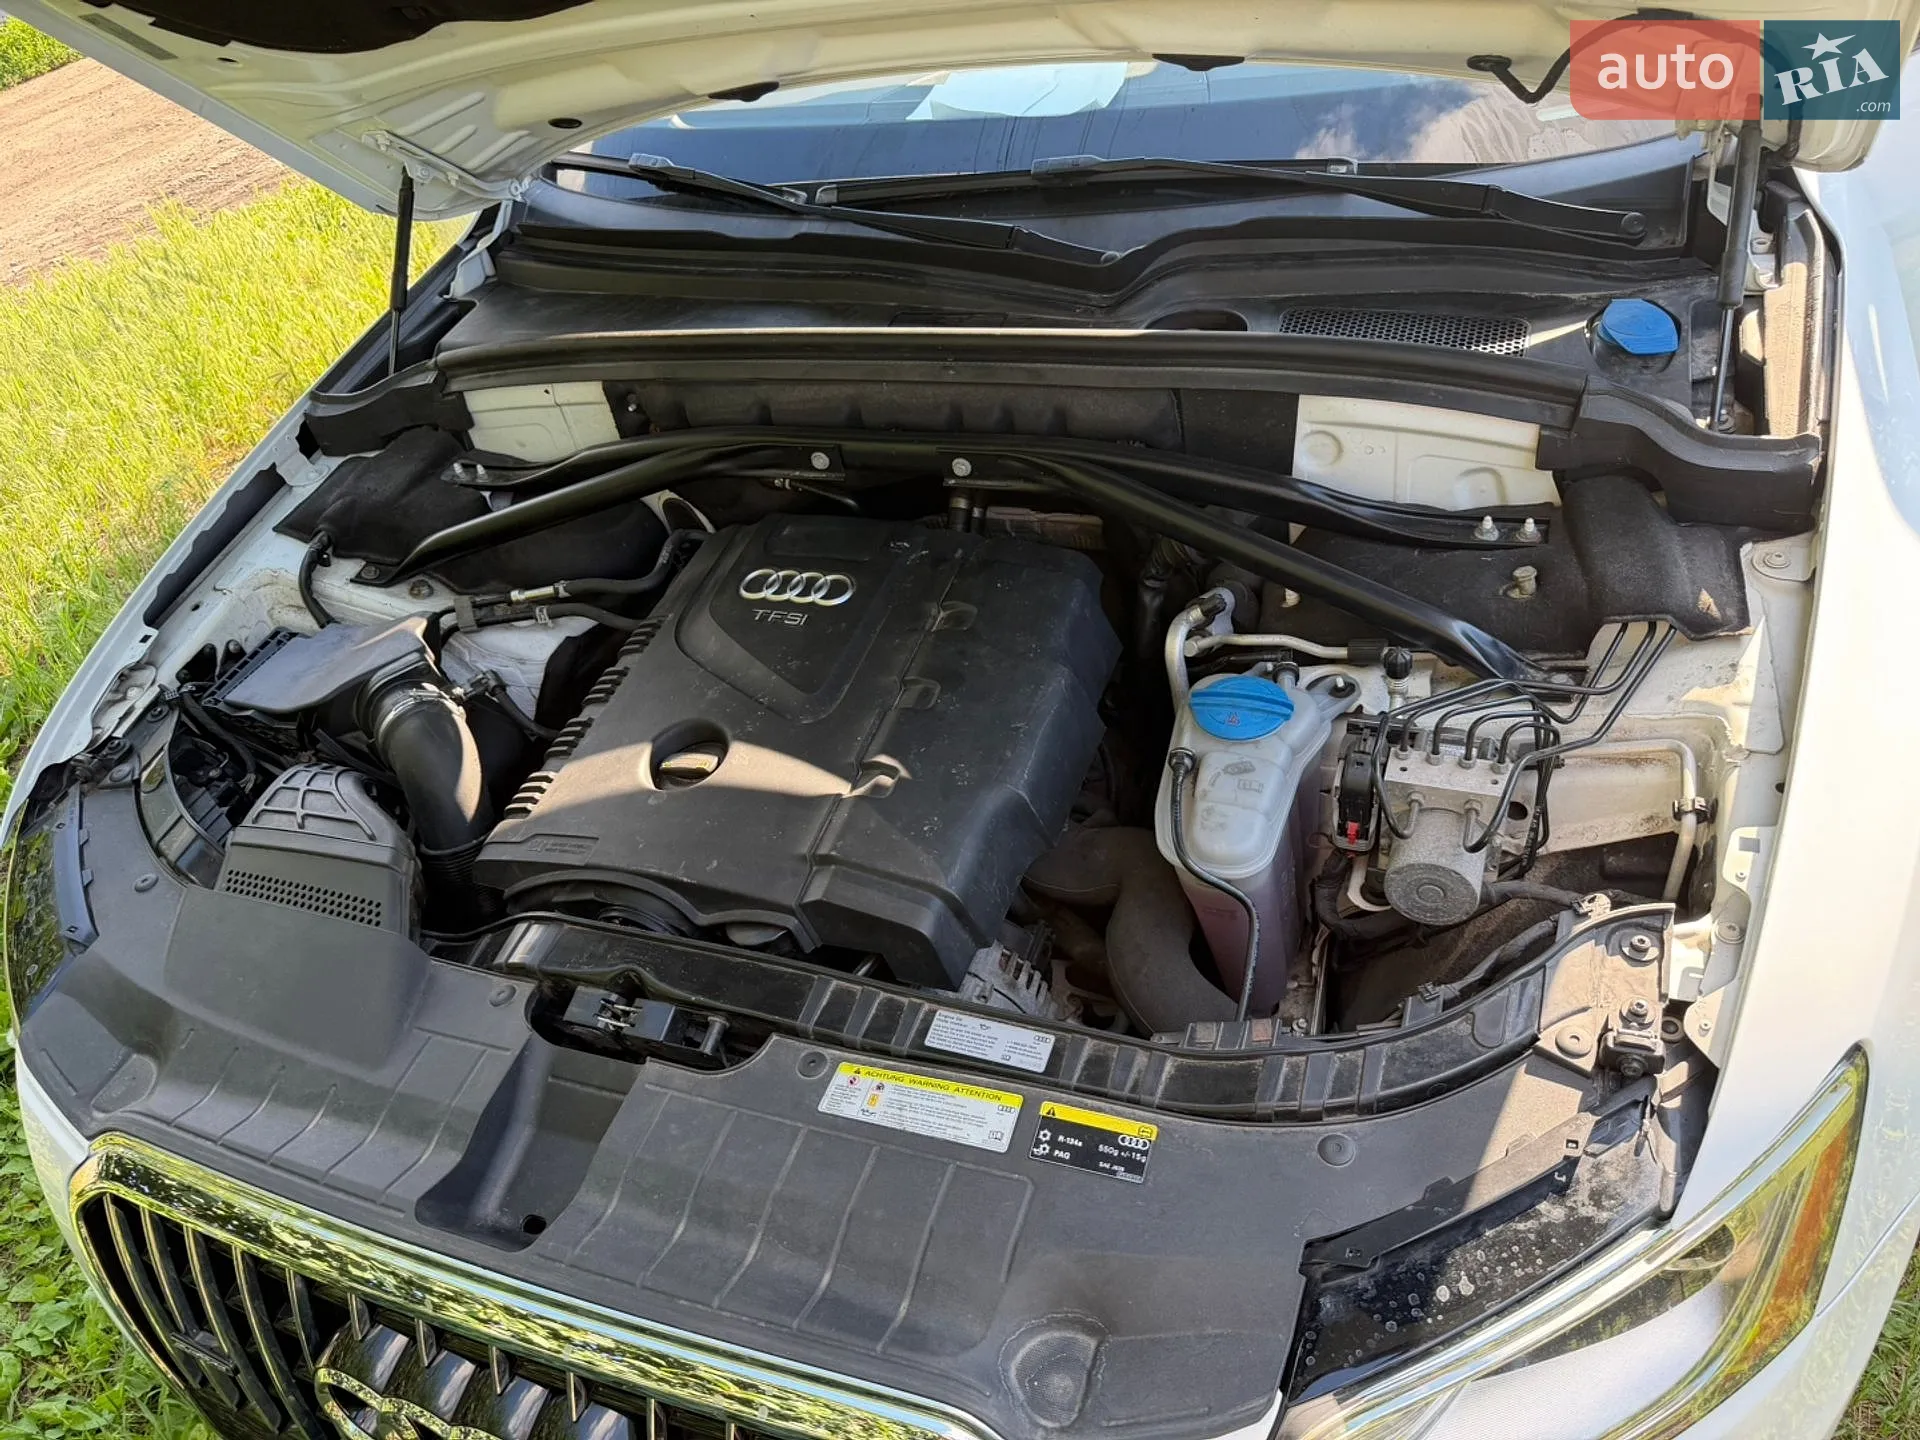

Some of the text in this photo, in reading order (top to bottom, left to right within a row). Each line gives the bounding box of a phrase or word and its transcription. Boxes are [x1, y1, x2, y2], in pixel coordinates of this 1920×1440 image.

[752, 609, 809, 626] TFSI
[864, 1070, 904, 1083] ACHTUNG
[908, 1077, 950, 1091] WARNING
[954, 1086, 1003, 1102] ATTENTION
[1053, 1149, 1071, 1160] PAG
